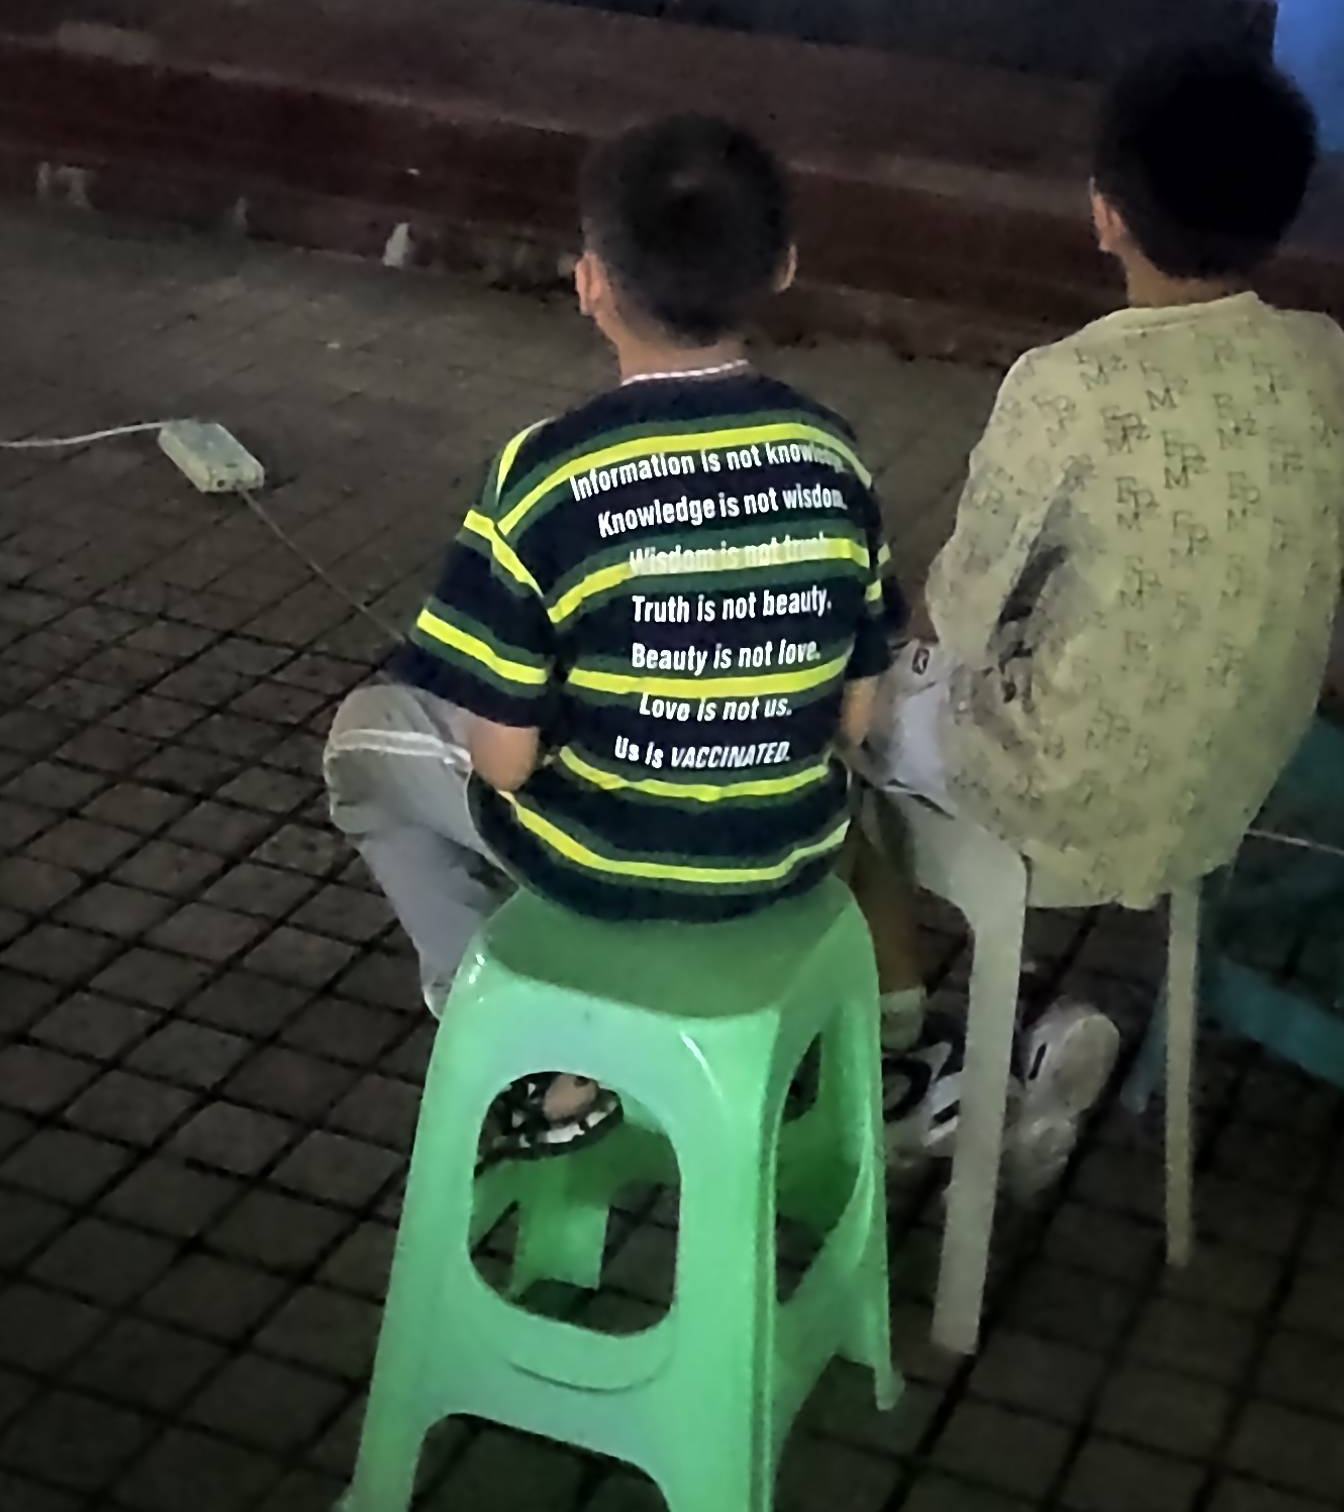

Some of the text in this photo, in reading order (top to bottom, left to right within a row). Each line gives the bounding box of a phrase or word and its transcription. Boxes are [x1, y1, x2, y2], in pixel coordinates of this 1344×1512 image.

[569, 451, 696, 502] Information
[700, 448, 721, 473] is
[726, 445, 762, 471] not
[597, 495, 717, 539] Knowledge
[718, 492, 740, 518] is
[743, 487, 779, 515] not
[631, 584, 832, 623] Truth is not beauty.
[631, 638, 821, 676] Beauty is not love.
[639, 691, 793, 722] Love is not us.
[614, 735, 791, 769] Us is VACCINATED.
